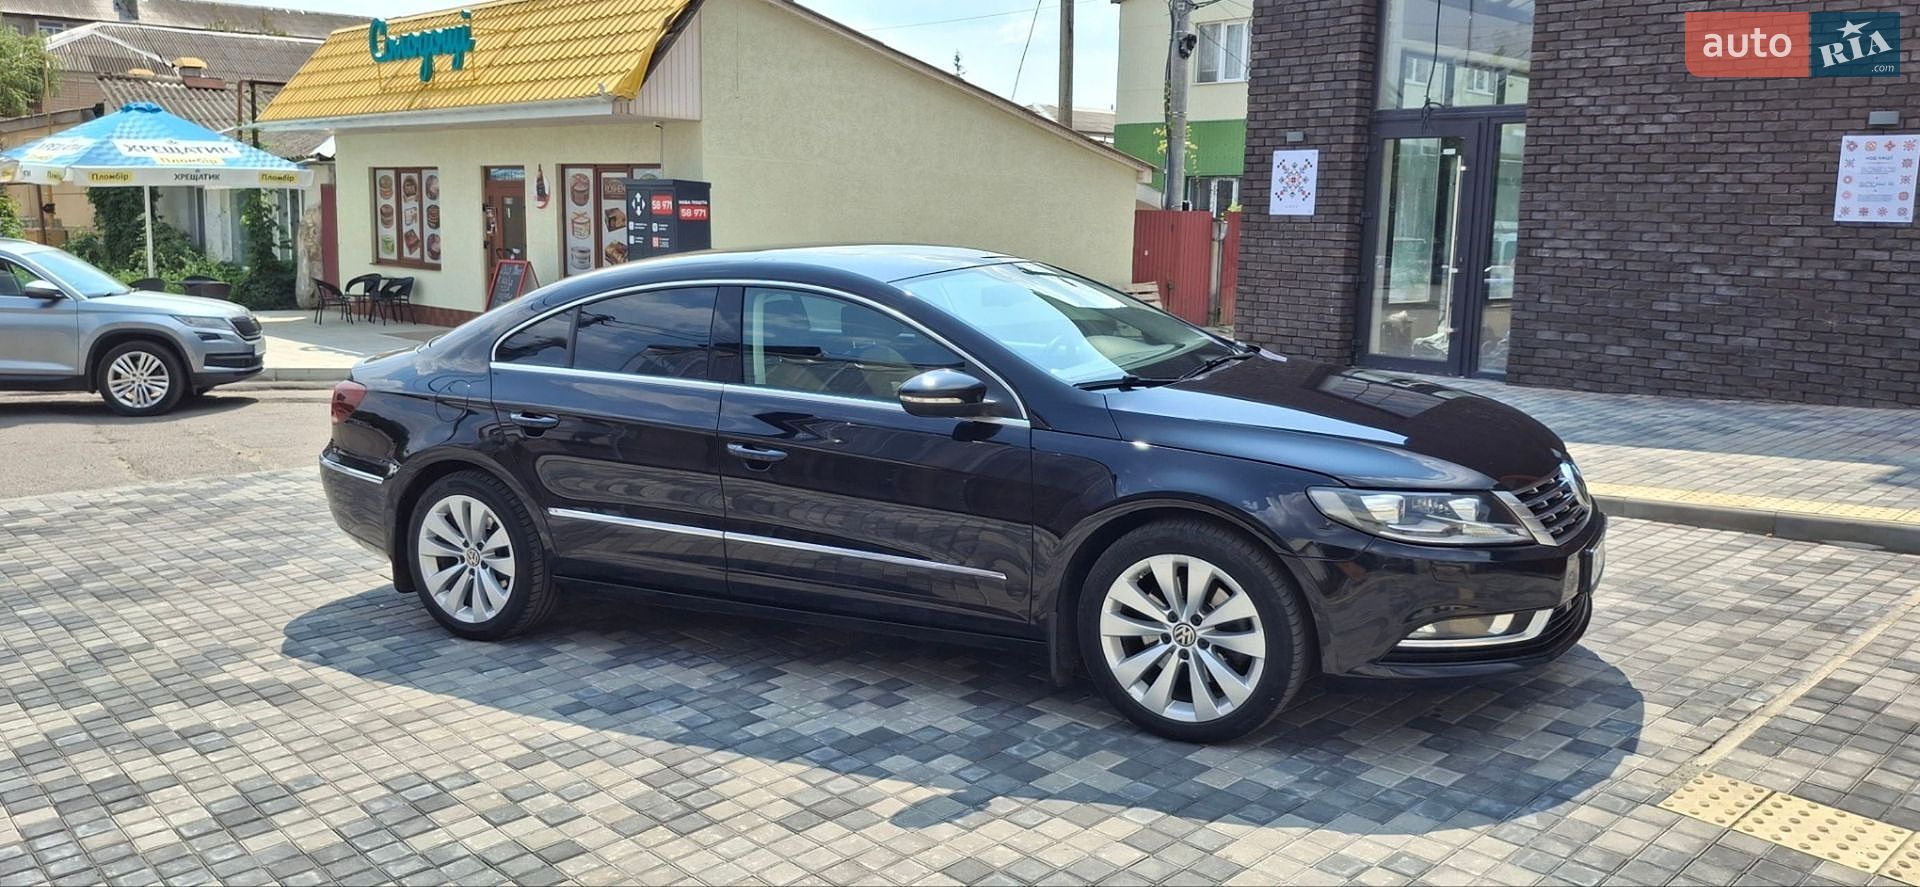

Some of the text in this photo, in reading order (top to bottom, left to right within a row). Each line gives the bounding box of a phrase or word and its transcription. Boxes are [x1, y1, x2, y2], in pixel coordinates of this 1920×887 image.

[123, 144, 234, 155] ХРЕЩАТИК
[91, 172, 130, 182] Пломбір
[174, 172, 221, 182] ХРЕЩАТИК
[261, 173, 295, 183] Пломбір
[651, 199, 673, 210] 58 971
[681, 208, 706, 217] 58 971
